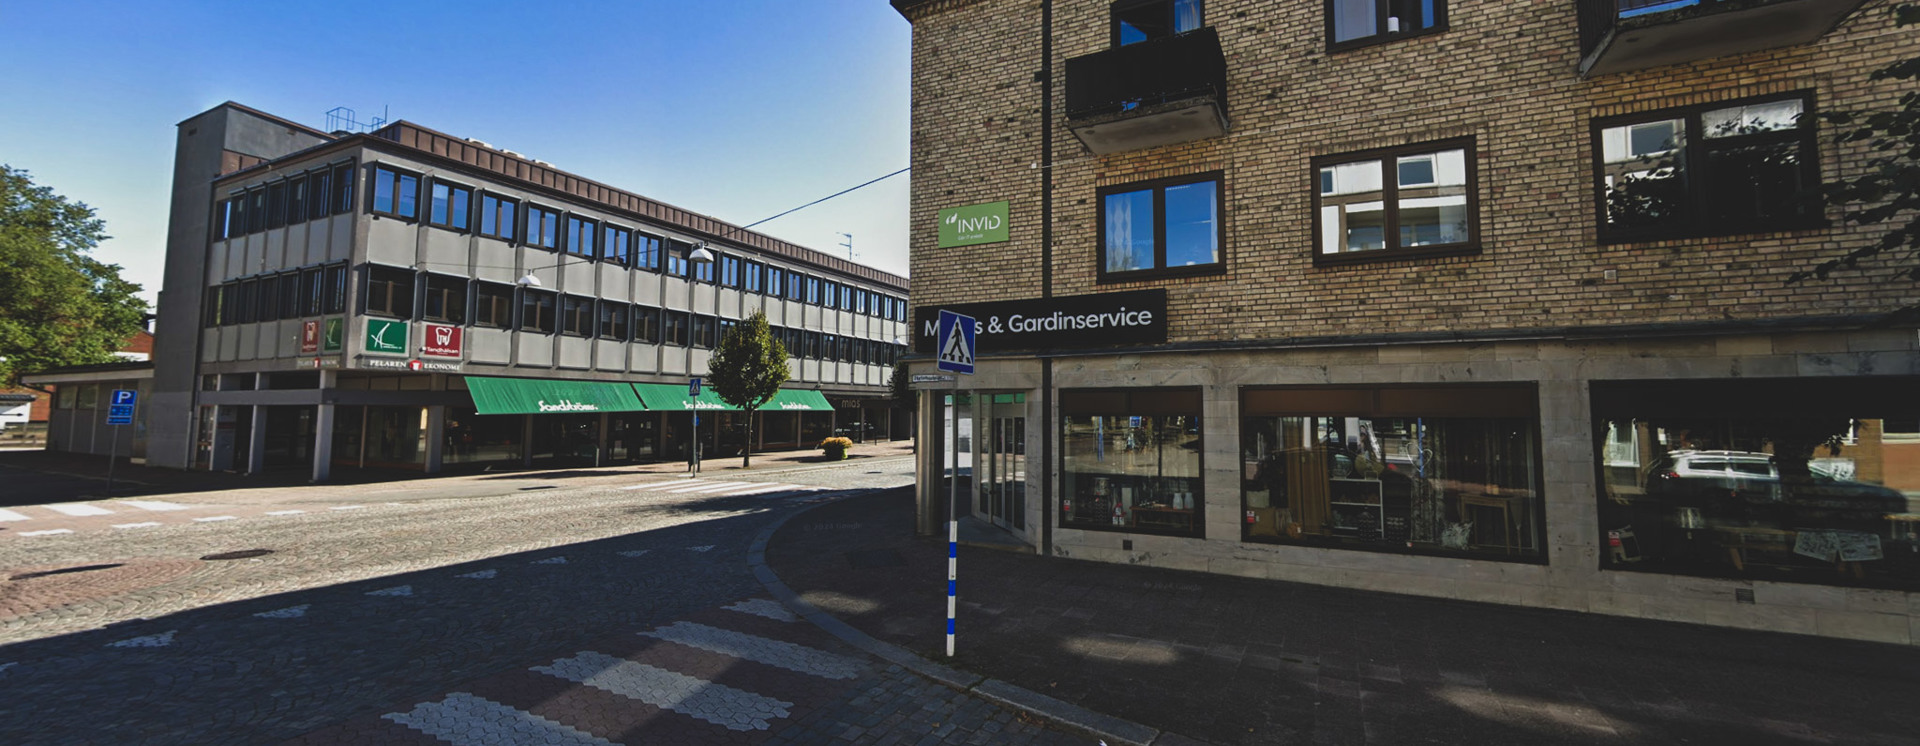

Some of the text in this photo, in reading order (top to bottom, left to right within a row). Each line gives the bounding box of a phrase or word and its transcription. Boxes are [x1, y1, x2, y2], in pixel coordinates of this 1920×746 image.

[958, 215, 1001, 234] INVID
[987, 315, 1004, 334] &
[1008, 306, 1153, 333] Gardinservice
[369, 360, 407, 369] PELAREN
[117, 391, 132, 404] P
